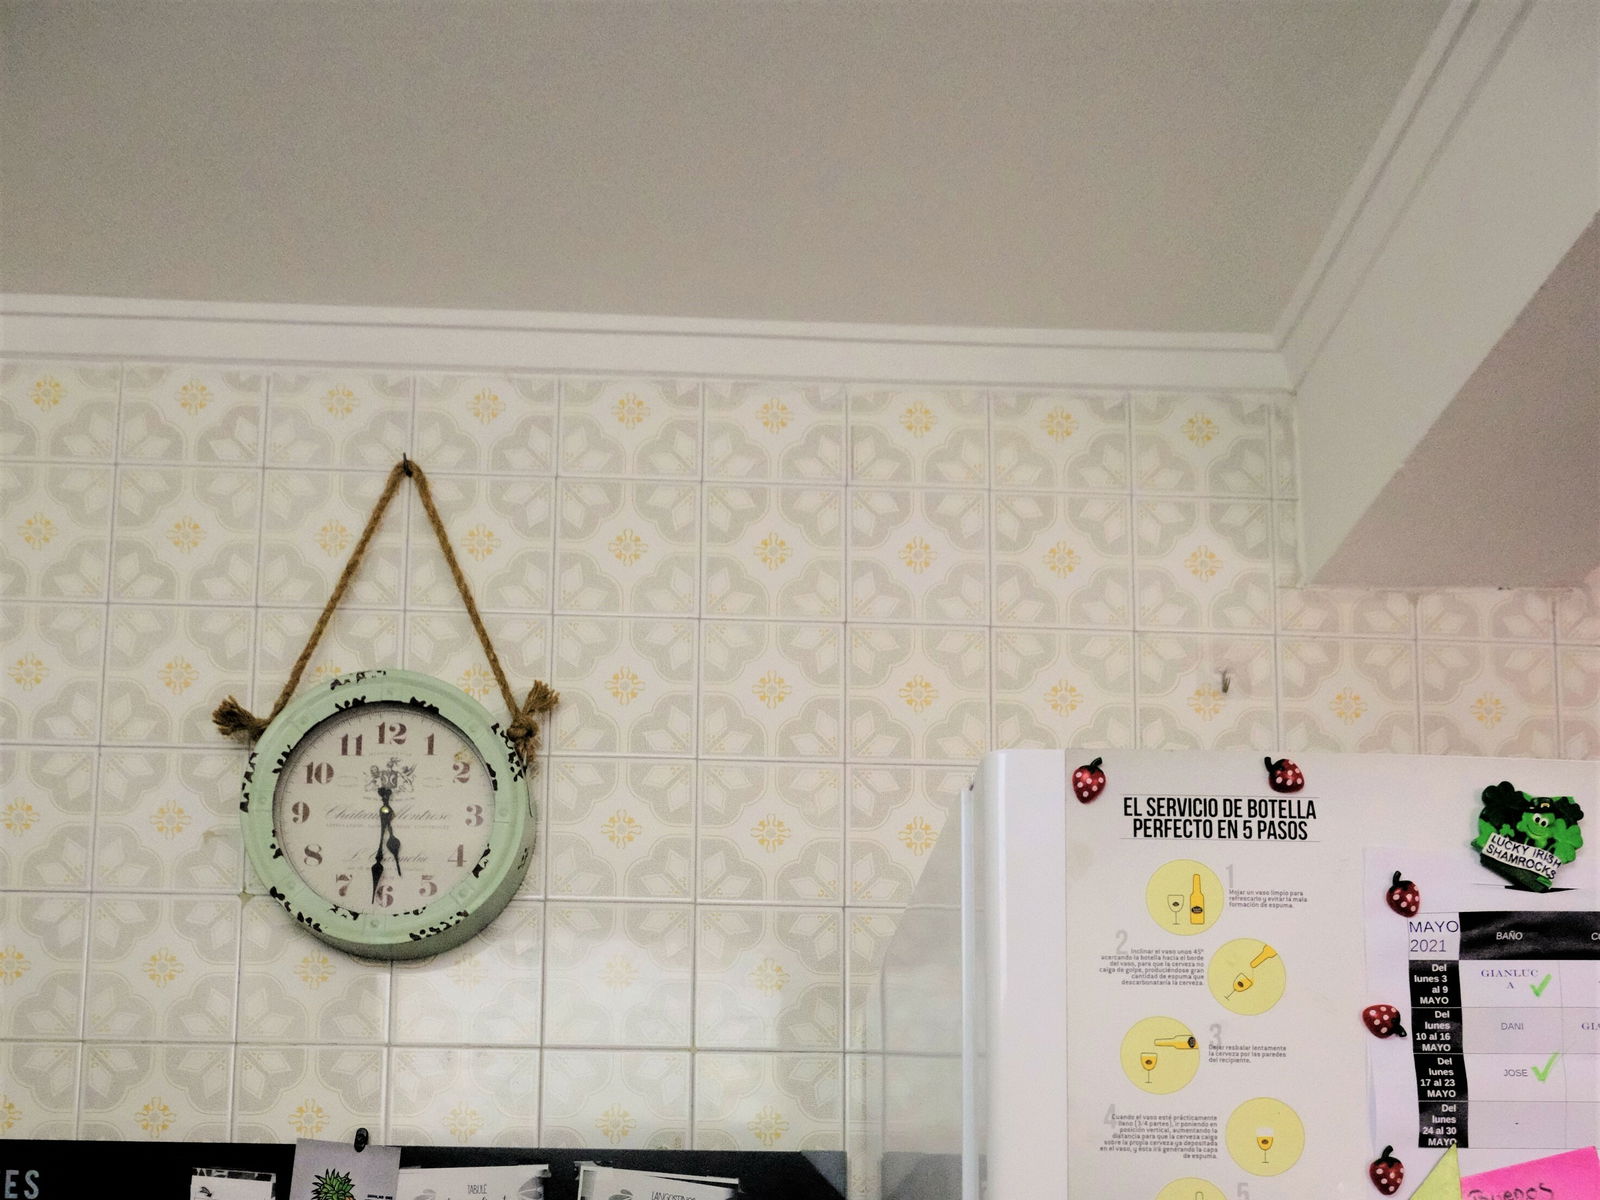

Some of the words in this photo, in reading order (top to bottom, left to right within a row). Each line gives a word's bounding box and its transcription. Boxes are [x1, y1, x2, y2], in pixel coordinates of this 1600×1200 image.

[377, 722, 406, 745] 12
[426, 733, 435, 755] 1
[341, 733, 363, 756] 11
[305, 762, 334, 784] 10
[452, 762, 470, 783] 2
[292, 801, 310, 824] 9
[465, 804, 483, 826] 3
[1124, 798, 1142, 816] EL
[1147, 798, 1218, 817] SERVICIO
[1223, 799, 1242, 818] DE
[1248, 799, 1316, 819] BOTELLA
[1134, 819, 1212, 838] PERFECTO
[1218, 820, 1237, 838] EN
[1243, 820, 1251, 839] 5
[1258, 821, 1307, 840] PASOS
[304, 844, 323, 865] 8
[448, 844, 467, 867] 4
[1492, 835, 1530, 855] LUCKY
[1487, 844, 1556, 879] SHAMROCKS
[336, 874, 352, 896] 7
[419, 875, 438, 897] 5
[1225, 864, 1233, 888] 1
[376, 885, 394, 907] 6
[1409, 921, 1458, 933] MAYO
[1496, 931, 1522, 940] BAÑO
[1116, 930, 1127, 954] 2
[1410, 940, 1446, 952] 2021
[1414, 975, 1439, 983] lunes
[1481, 969, 1538, 977] GIANLUC
[1435, 1010, 1449, 1018] Del
[1501, 1022, 1523, 1030] DANI
[1429, 1068, 1453, 1076] lunes
[1504, 1069, 1528, 1077] JOSE
[1427, 1090, 1456, 1098] MAYO
[1442, 1104, 1456, 1112] Del
[1432, 1115, 1456, 1123] lunes
[1428, 1138, 1456, 1146] MAYO
[0, 1169, 40, 1199] ES
